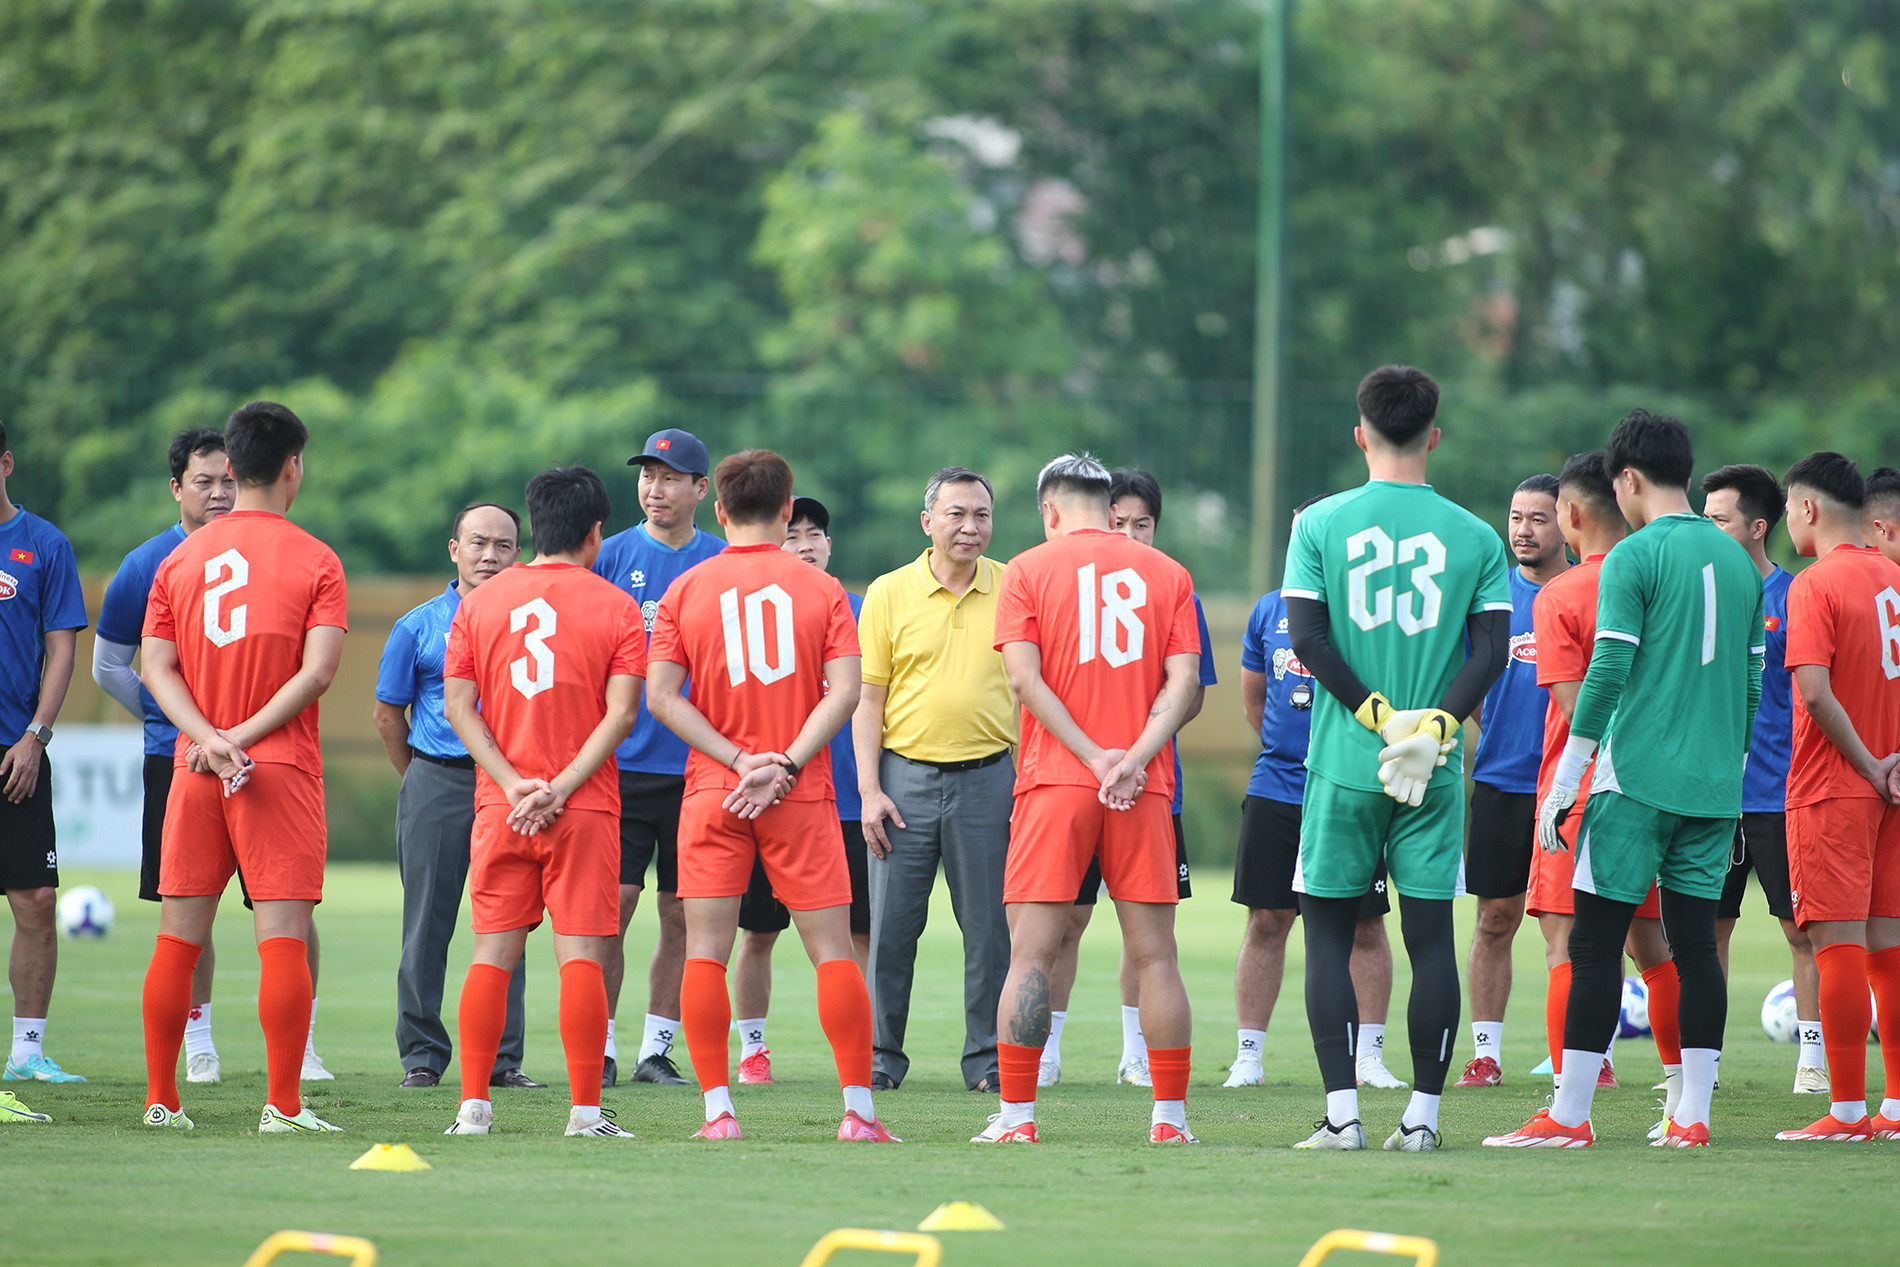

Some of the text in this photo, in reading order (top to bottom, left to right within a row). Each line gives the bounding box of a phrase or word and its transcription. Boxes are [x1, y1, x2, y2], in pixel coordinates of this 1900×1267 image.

[204, 548, 249, 647] 2
[1077, 562, 1147, 668] 18
[1346, 526, 1447, 636] 23
[1702, 563, 1717, 665] 1
[510, 597, 557, 701] 3
[720, 583, 795, 687] 10
